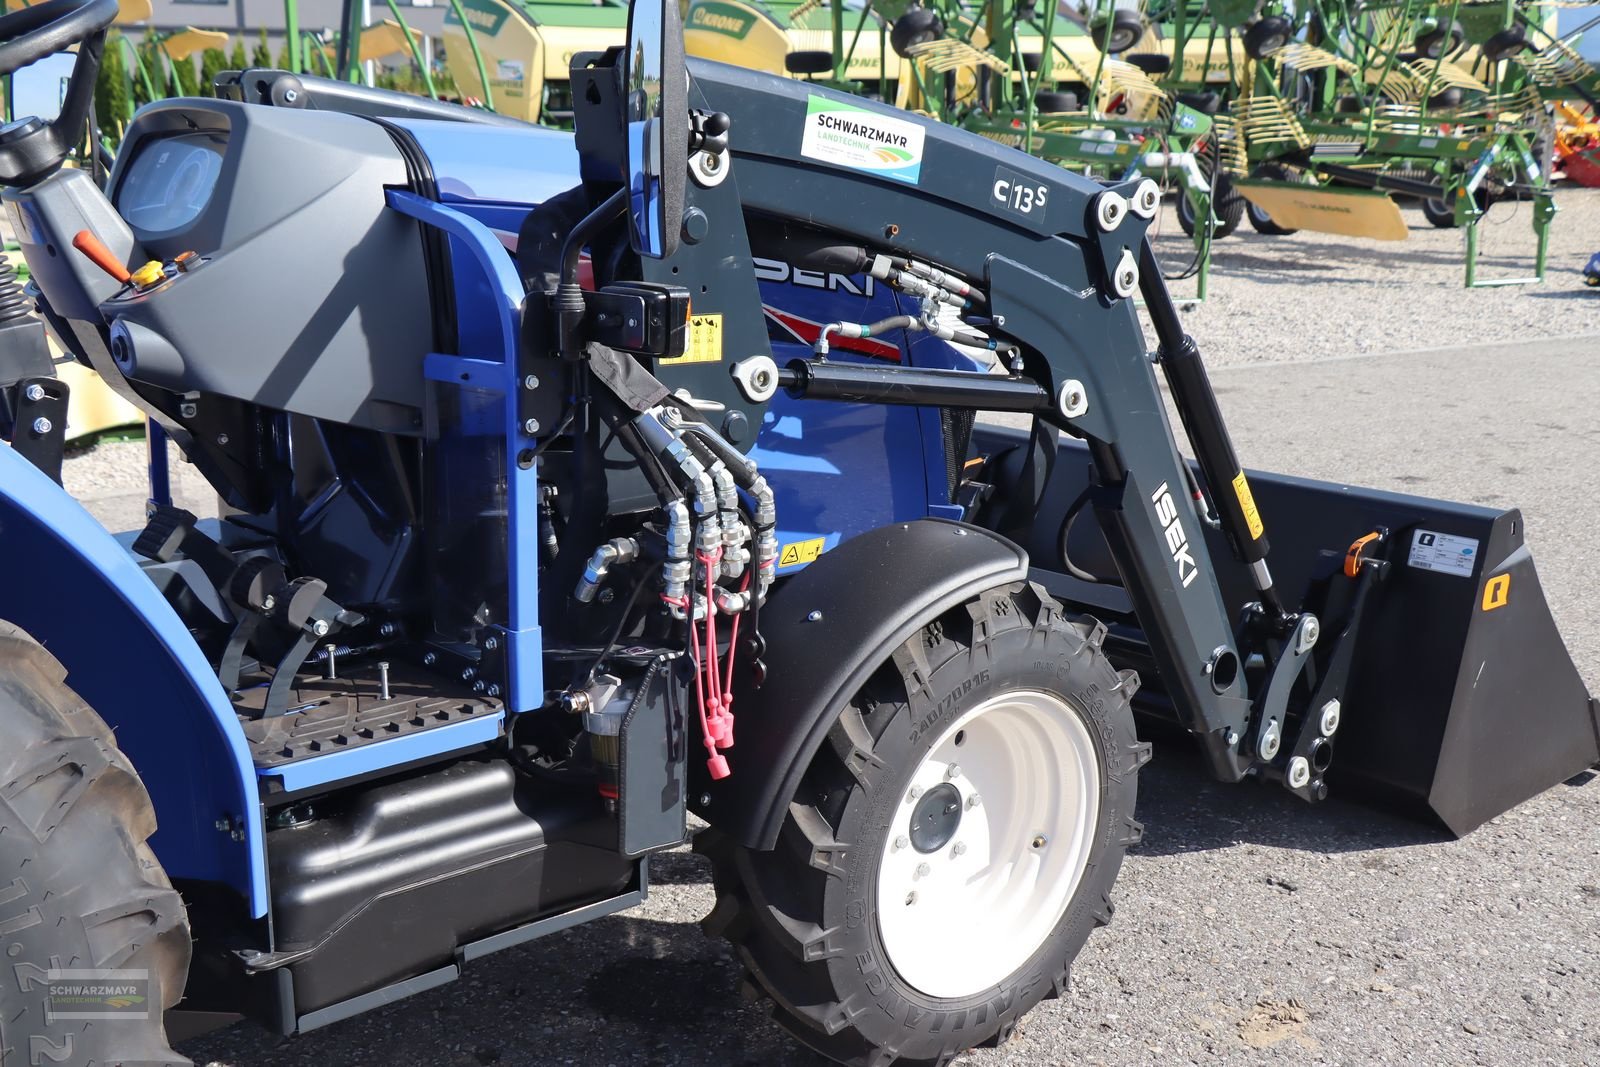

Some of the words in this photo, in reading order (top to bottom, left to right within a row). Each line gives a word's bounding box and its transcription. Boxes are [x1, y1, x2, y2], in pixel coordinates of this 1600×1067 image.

[703, 12, 745, 32] KRONE
[848, 57, 881, 68] ONE
[817, 131, 871, 151] LANDTECHNIK
[818, 114, 908, 148] SCHWARZMAYR
[752, 257, 874, 297] SEKI
[1151, 481, 1198, 589] ISEKI
[908, 669, 990, 746] 240/70R16
